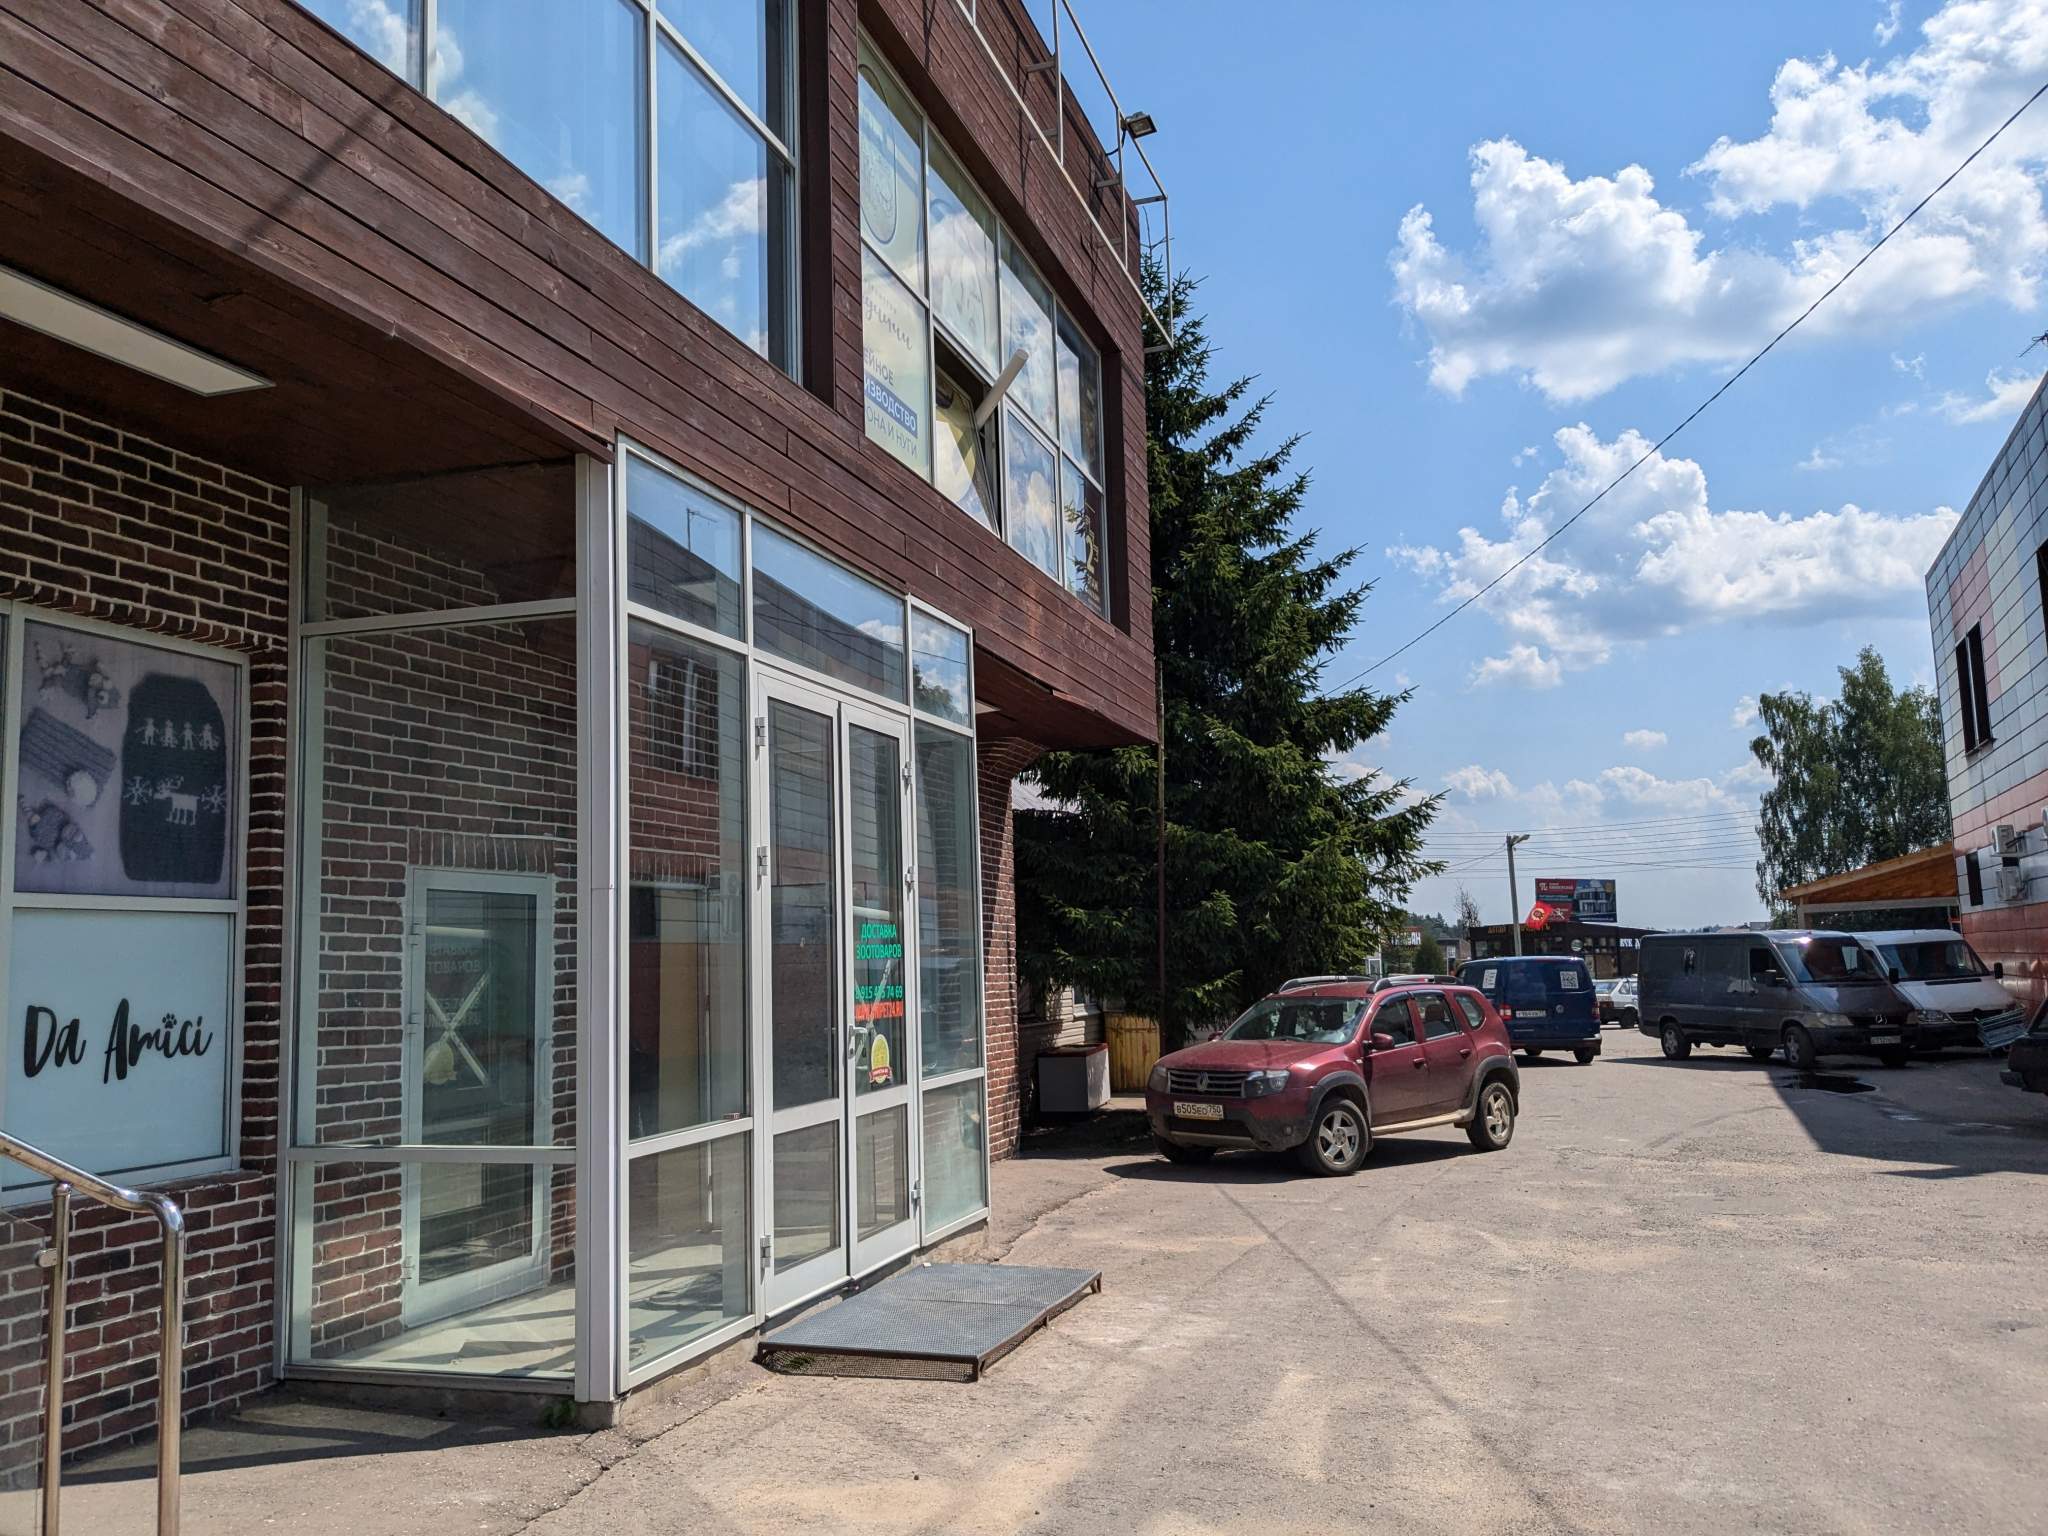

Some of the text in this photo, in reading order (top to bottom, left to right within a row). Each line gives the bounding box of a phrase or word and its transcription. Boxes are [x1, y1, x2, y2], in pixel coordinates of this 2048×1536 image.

[861, 923, 897, 941] ДОСТАВКА
[855, 943, 902, 960] ЗООТОВАРОВ
[24, 998, 213, 1084] Da Amici
